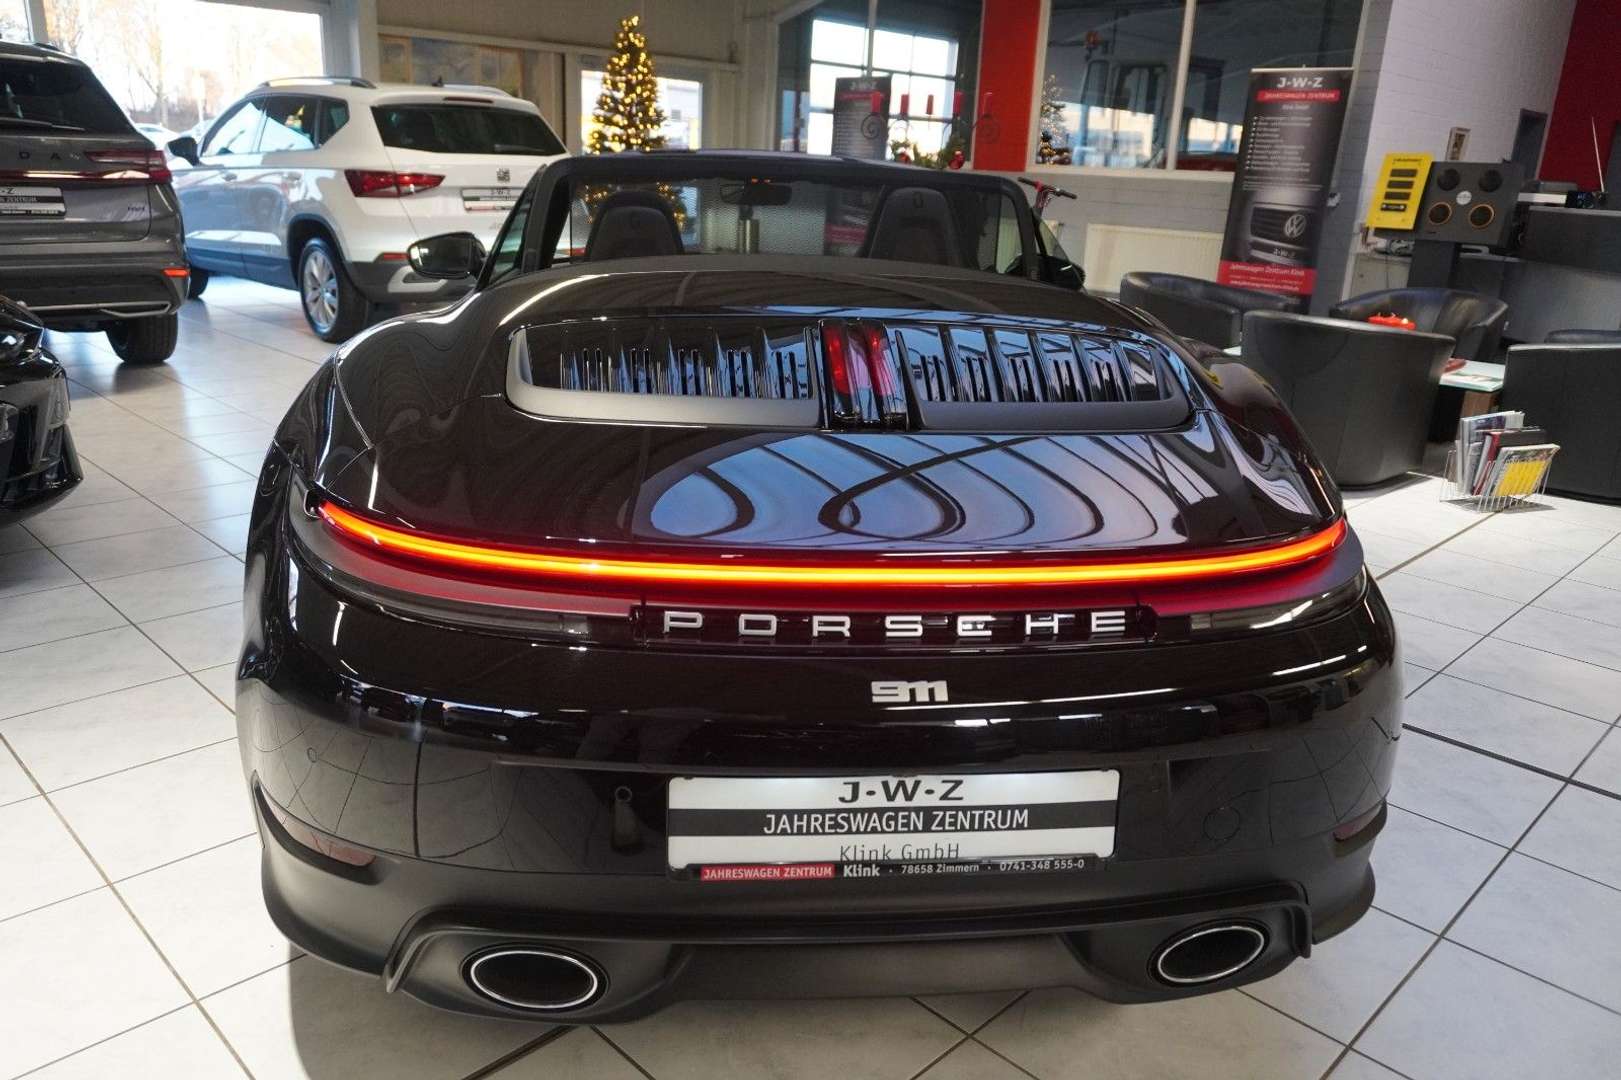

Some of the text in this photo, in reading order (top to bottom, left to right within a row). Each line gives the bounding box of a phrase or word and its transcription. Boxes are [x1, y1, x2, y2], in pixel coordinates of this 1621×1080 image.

[664, 609, 1126, 638] PORSCHE
[763, 808, 1029, 834] JAHRESWAGEN ZENTRUM
[840, 842, 960, 861] Klink GmbH
[703, 859, 1086, 880] JAHRESWAGEN ZENTRUM Klink 78658 Zimmern 0741-348 555-0
